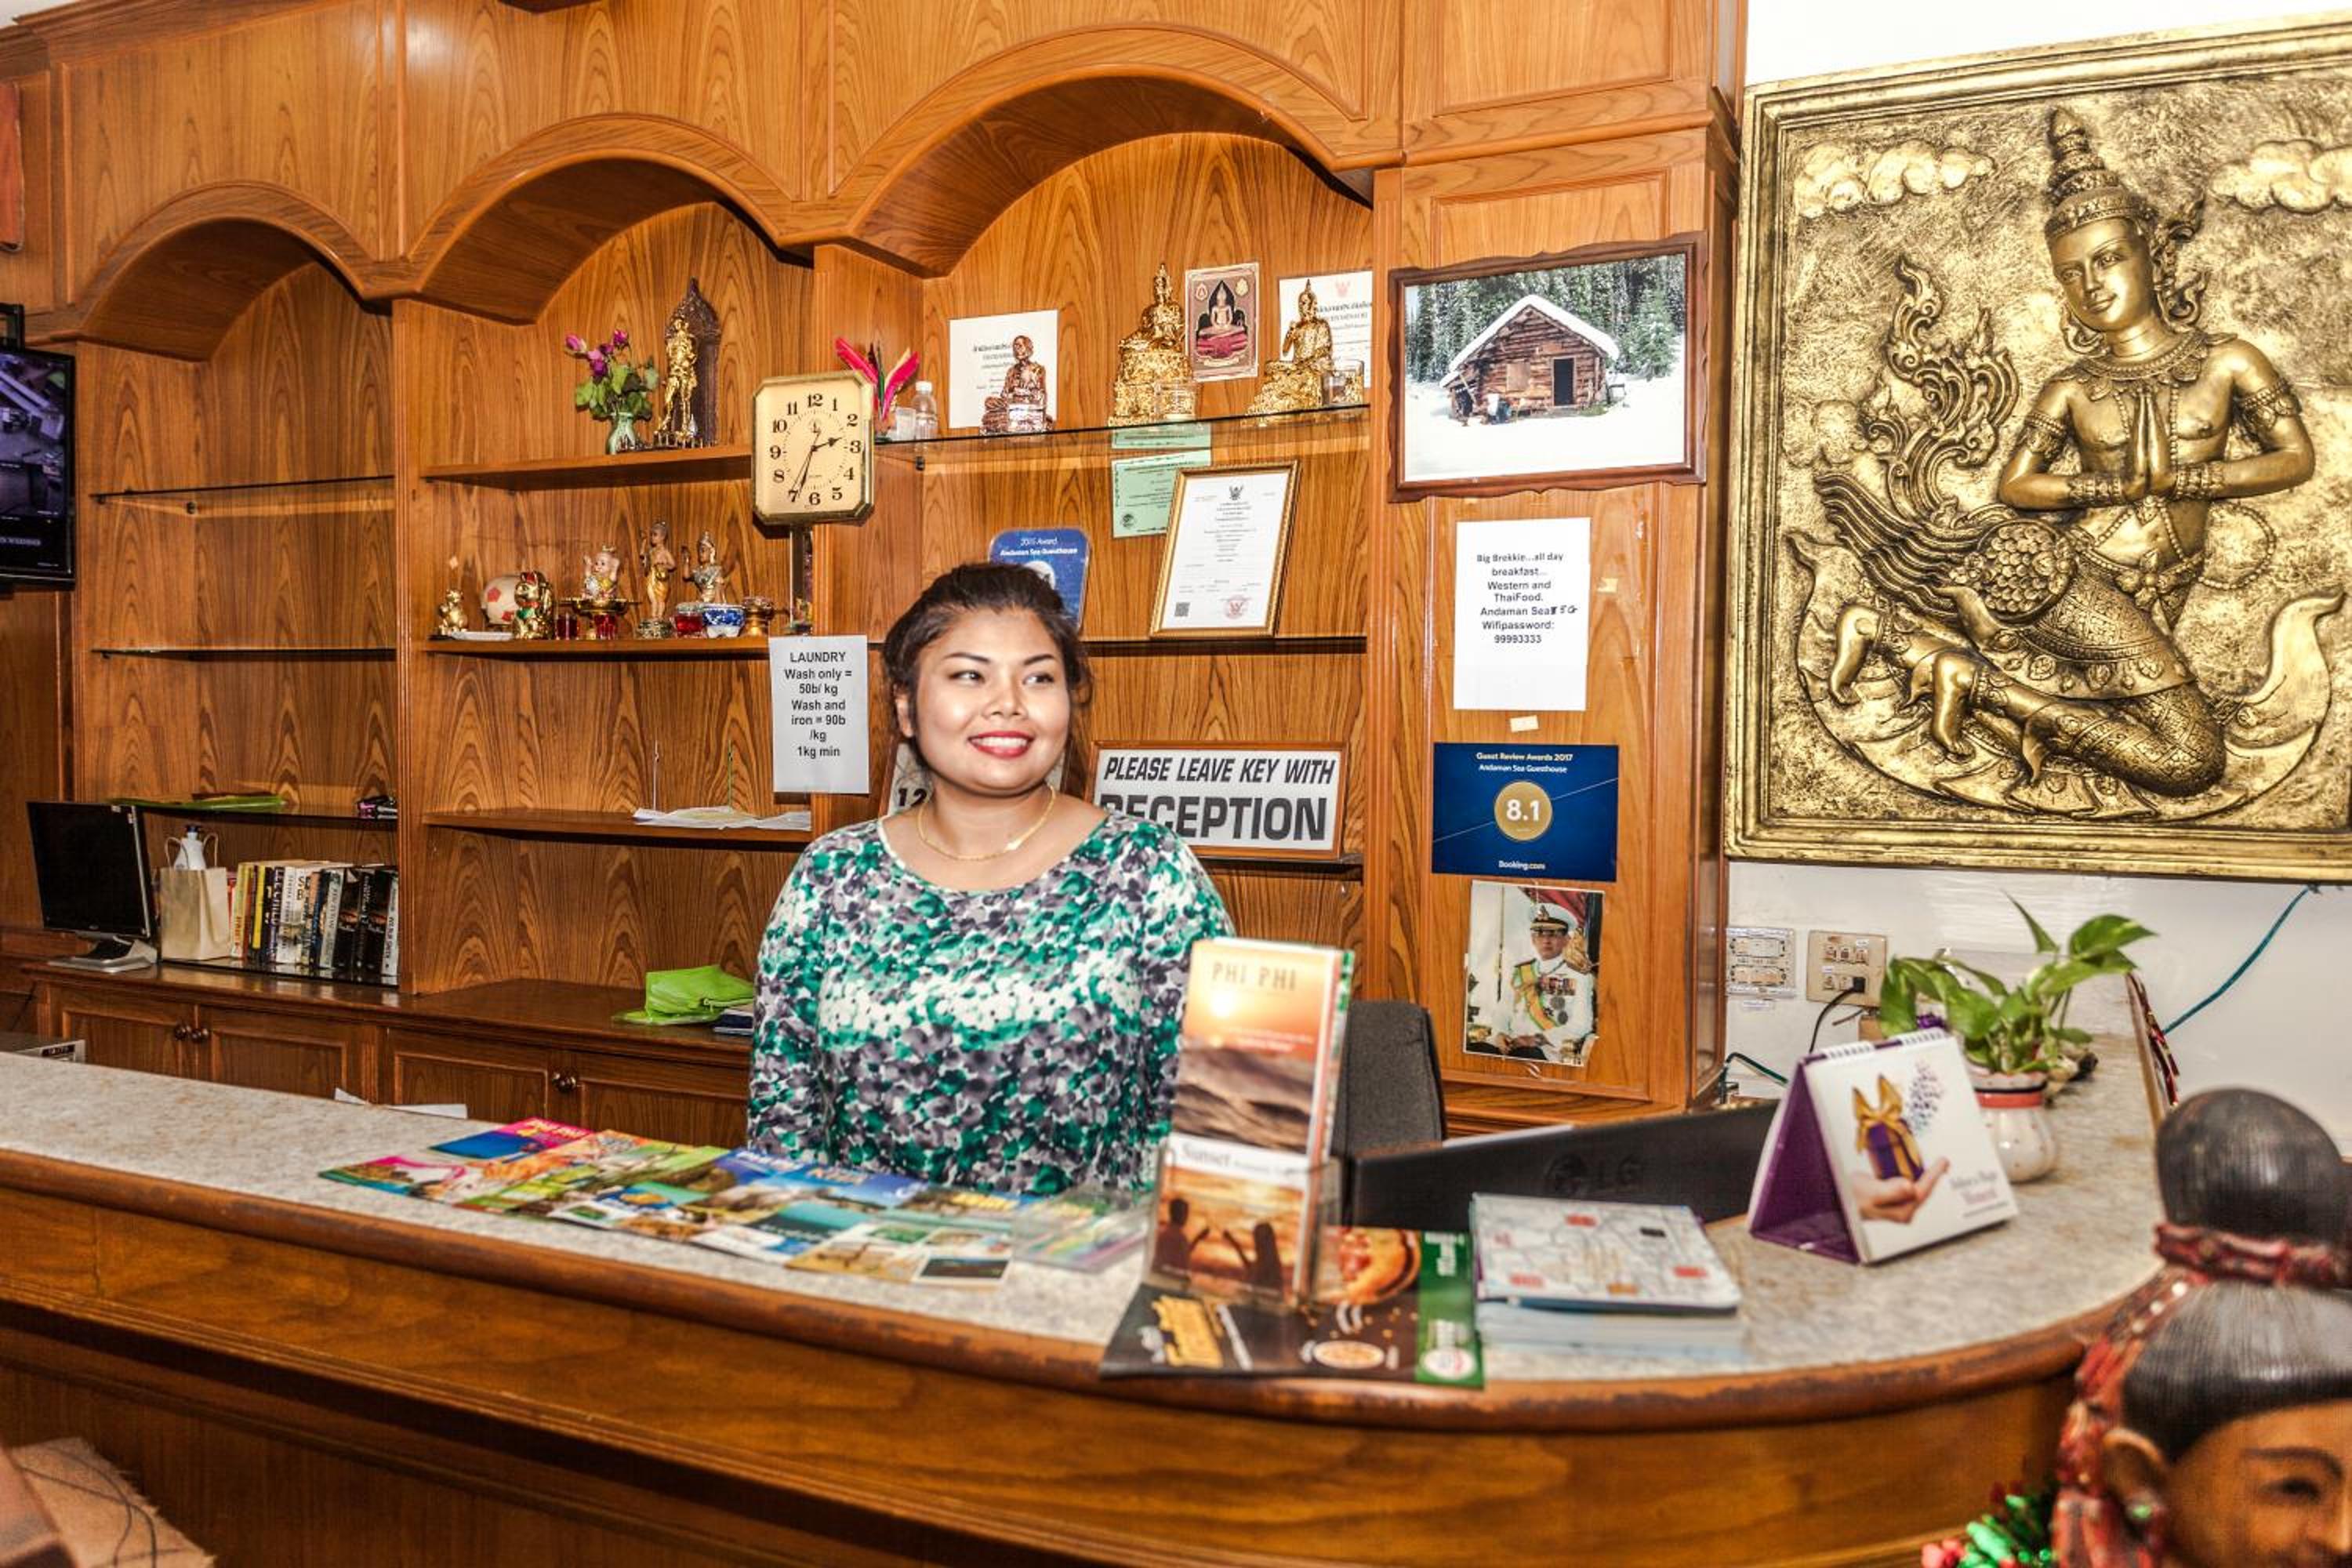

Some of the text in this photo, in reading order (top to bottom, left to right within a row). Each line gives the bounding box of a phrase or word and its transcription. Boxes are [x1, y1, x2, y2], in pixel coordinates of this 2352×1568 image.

[807, 393, 823, 408] 12
[833, 397, 838, 412] 1
[787, 401, 797, 416] 11
[773, 419, 787, 433] 10
[847, 414, 858, 426] 2
[770, 445, 781, 459] 9
[850, 441, 861, 453] 3
[773, 470, 784, 483] 8
[844, 467, 854, 480] 4
[788, 489, 798, 503] 7
[809, 492, 821, 505] 6
[832, 487, 843, 500] 5
[1477, 554, 1490, 564] Big
[1547, 552, 1563, 562] day
[1487, 580, 1552, 590] Western and
[1480, 607, 1528, 615] Andaman
[789, 652, 846, 662] LAUNDRY
[785, 670, 815, 679] Wash
[818, 669, 842, 681] only
[824, 684, 838, 696] kg
[791, 700, 846, 710] Wash and
[791, 715, 812, 725] iron
[826, 715, 846, 725] 90b
[809, 730, 826, 742] /kg
[797, 746, 840, 759] 1kg min
[1104, 757, 1336, 784] PLEASE LEAVE KEY WITH
[1526, 764, 1567, 773] Guesthouse
[1505, 799, 1540, 822] 8.1
[1498, 860, 1546, 870] Booking.com
[1212, 962, 1295, 991] PHI PHI
